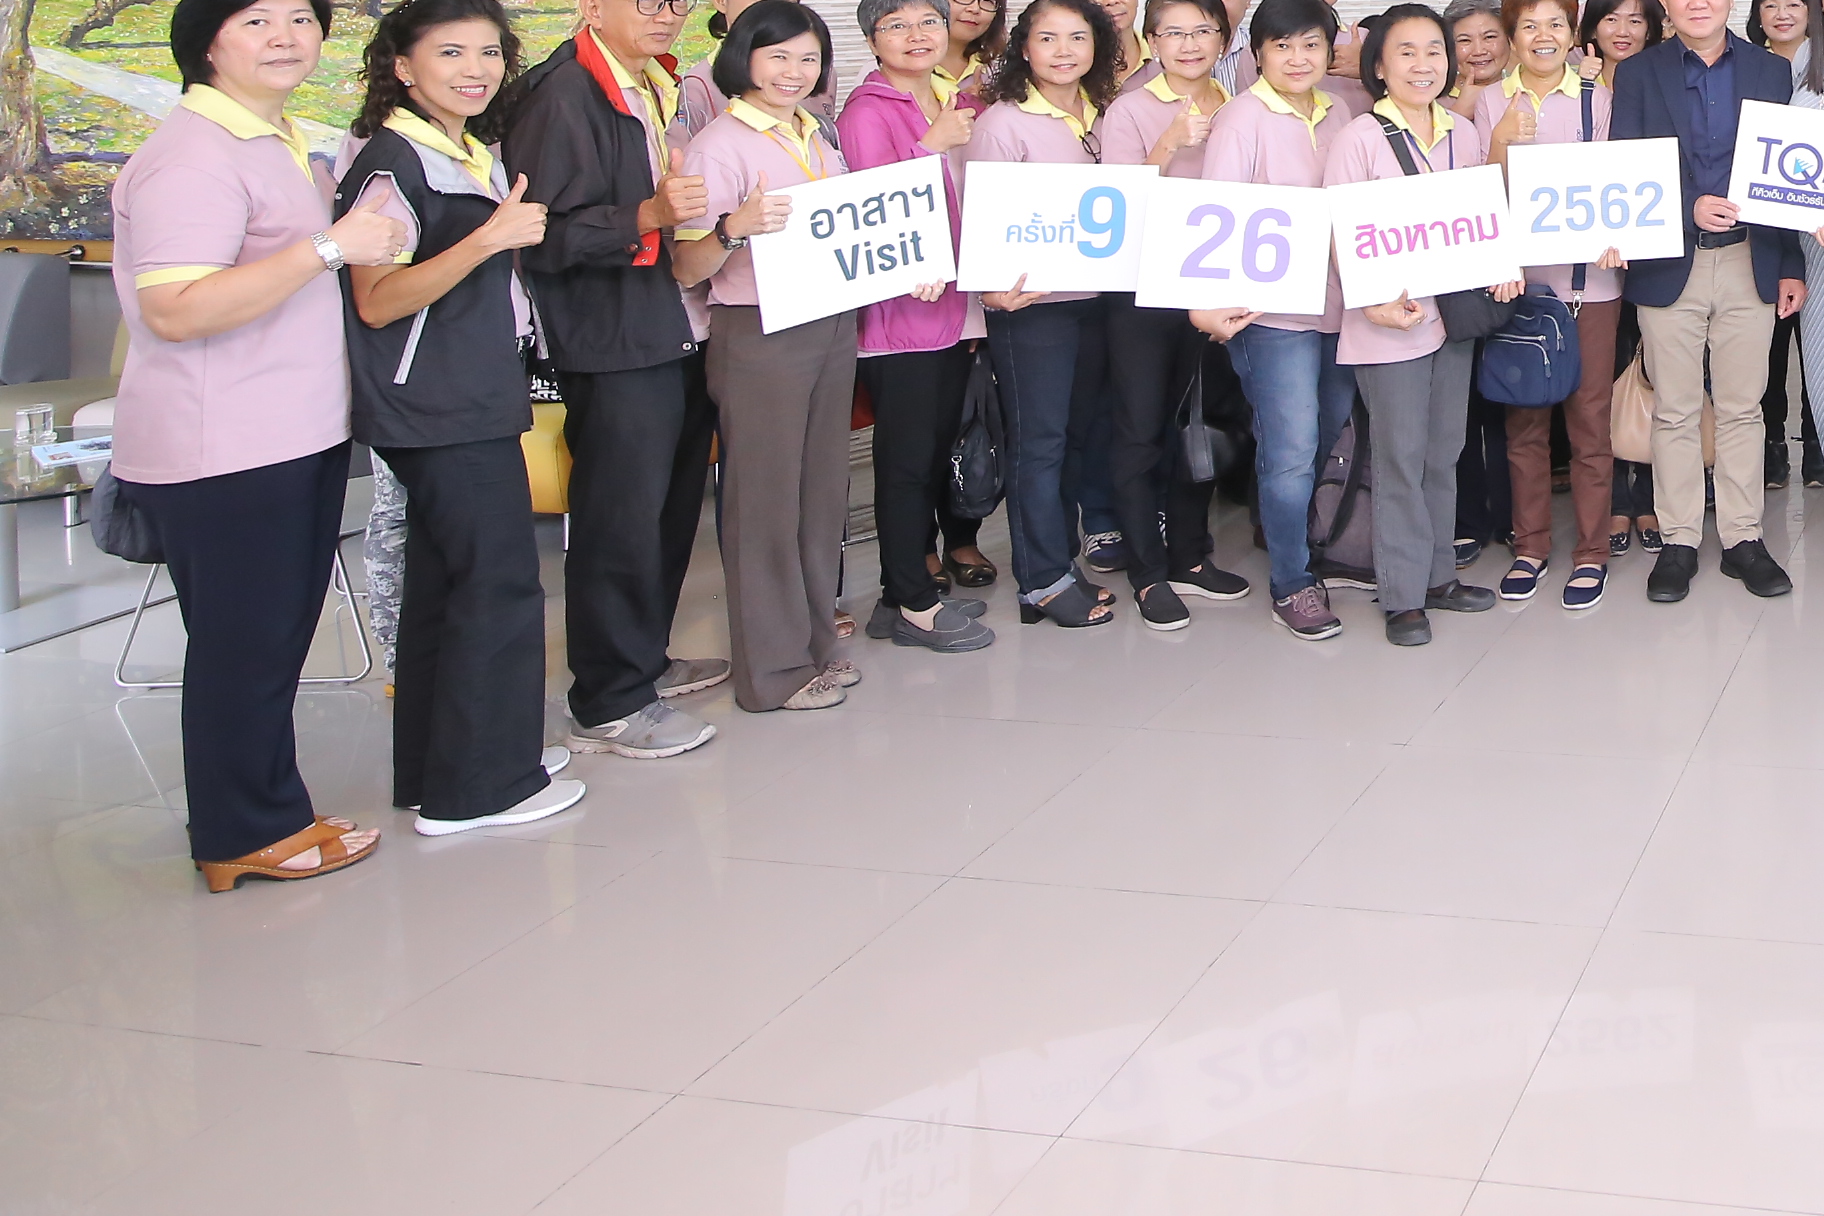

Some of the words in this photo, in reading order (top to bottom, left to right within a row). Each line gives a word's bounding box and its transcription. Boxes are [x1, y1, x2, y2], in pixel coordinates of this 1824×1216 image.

[810, 183, 935, 240] อาสาฯ
[1530, 181, 1666, 233] 2562
[1751, 186, 1784, 200] ทีคิวเอ็ม
[1077, 186, 1127, 258] 9
[1179, 203, 1291, 283] 26
[1354, 213, 1499, 259] สิงหาคม
[833, 230, 925, 281] Visit
